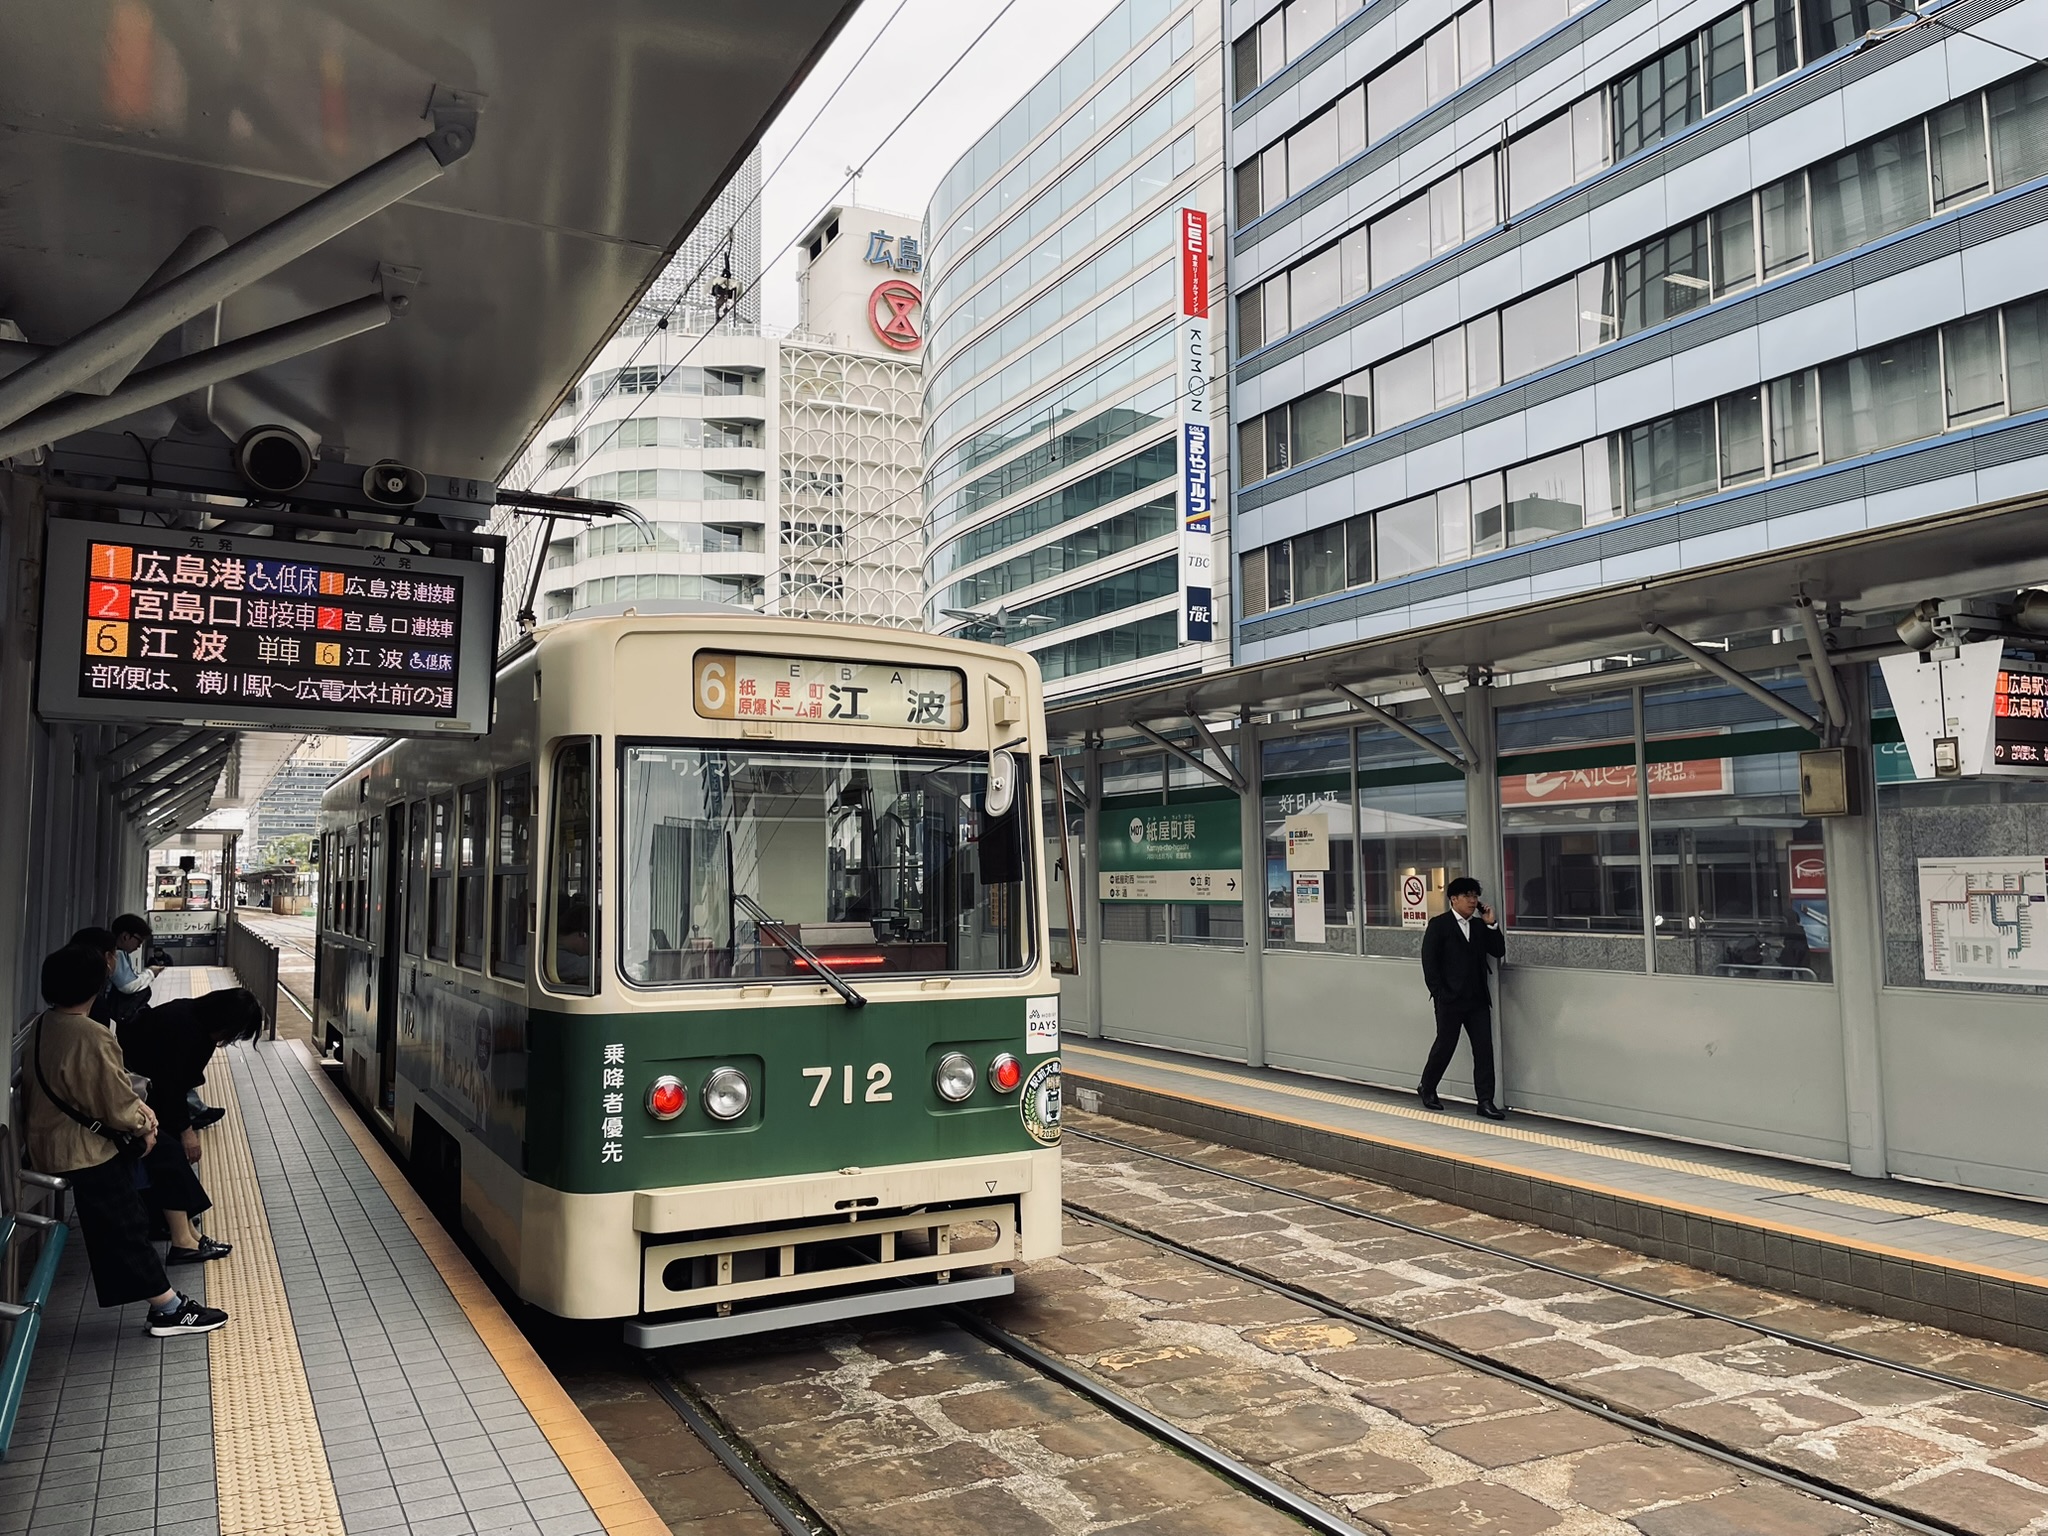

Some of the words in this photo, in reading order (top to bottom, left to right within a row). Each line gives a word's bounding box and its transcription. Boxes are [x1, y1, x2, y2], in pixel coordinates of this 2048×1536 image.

[1187, 213, 1202, 253] LEC
[863, 229, 922, 275] 広島
[1188, 329, 1205, 413] KUMON
[190, 536, 232, 551] 先発
[373, 554, 412, 569] 次発
[1188, 556, 1210, 568] TBC
[132, 551, 247, 591] 広島港
[276, 564, 319, 595] 低床
[345, 576, 411, 601] 広島港
[413, 582, 456, 604] 連接車
[99, 586, 120, 617] 2
[131, 588, 242, 627] 宮島口
[247, 600, 316, 631] 連接車
[323, 608, 335, 630] 2
[344, 611, 408, 634] 宮島口
[411, 616, 454, 639] 連接車
[1189, 611, 1210, 622] TBC
[96, 624, 118, 653] 6
[140, 626, 228, 663] 江波
[257, 635, 301, 666] 単車
[322, 645, 335, 664] 6
[346, 647, 403, 669] 江波
[425, 653, 452, 671] 低床
[700, 662, 726, 710] 6
[738, 679, 825, 700] 紙屋町
[2008, 674, 2044, 696] 広島駅
[738, 698, 823, 719] 原爆ドーム前
[828, 684, 946, 725] 江波
[2008, 697, 2044, 718] 広島駅
[671, 758, 746, 777] ワンマン
[1146, 819, 1196, 841] 紙屋町東
[184, 922, 211, 931] シャレオ
[1030, 1020, 1057, 1031] DAYS
[802, 1062, 893, 1107] 712
[601, 1043, 625, 1163] 乗降者優先
